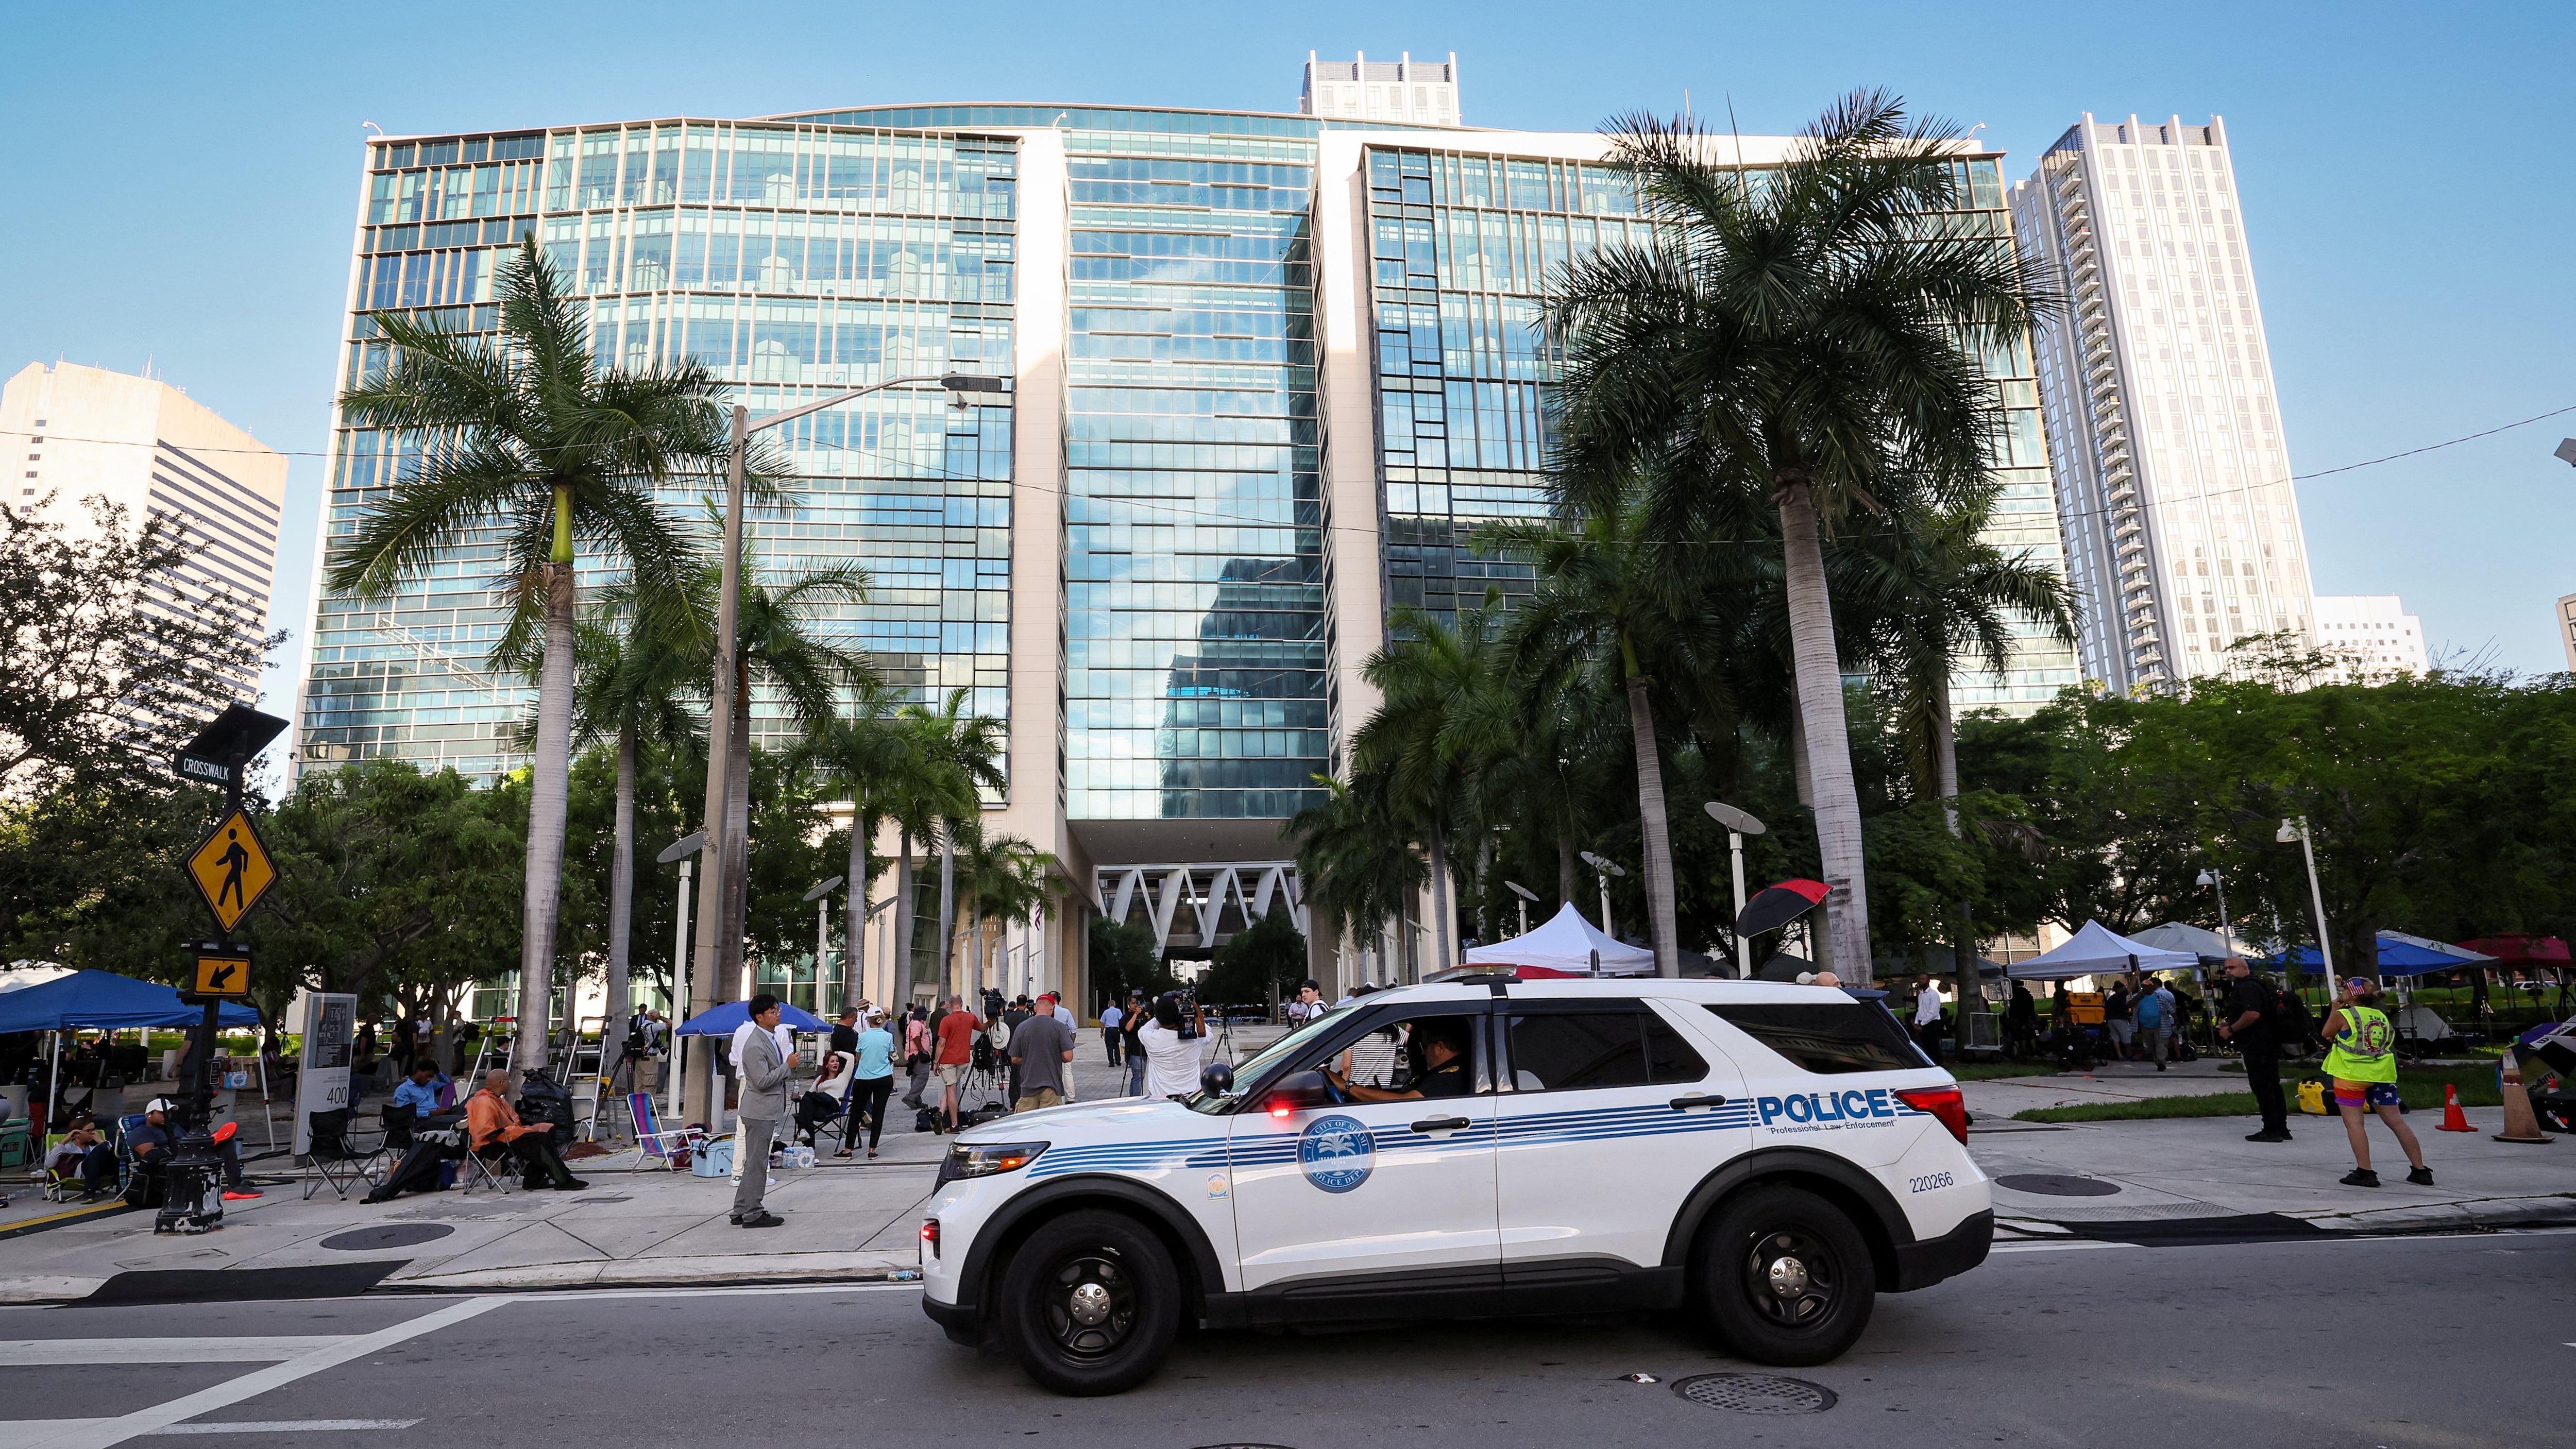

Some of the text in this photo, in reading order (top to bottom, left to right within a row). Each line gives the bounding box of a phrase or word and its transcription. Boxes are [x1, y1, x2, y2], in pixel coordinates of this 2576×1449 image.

[184, 758, 229, 780] CROSSWALK
[327, 1086, 347, 1104] 400
[1757, 1088, 1895, 1126] POLICE
[1315, 1121, 1332, 1134] CITY
[1348, 1124, 1367, 1147] MIAMI
[1312, 1168, 1342, 1185] POLICE
[1909, 1171, 1954, 1193] 220266
